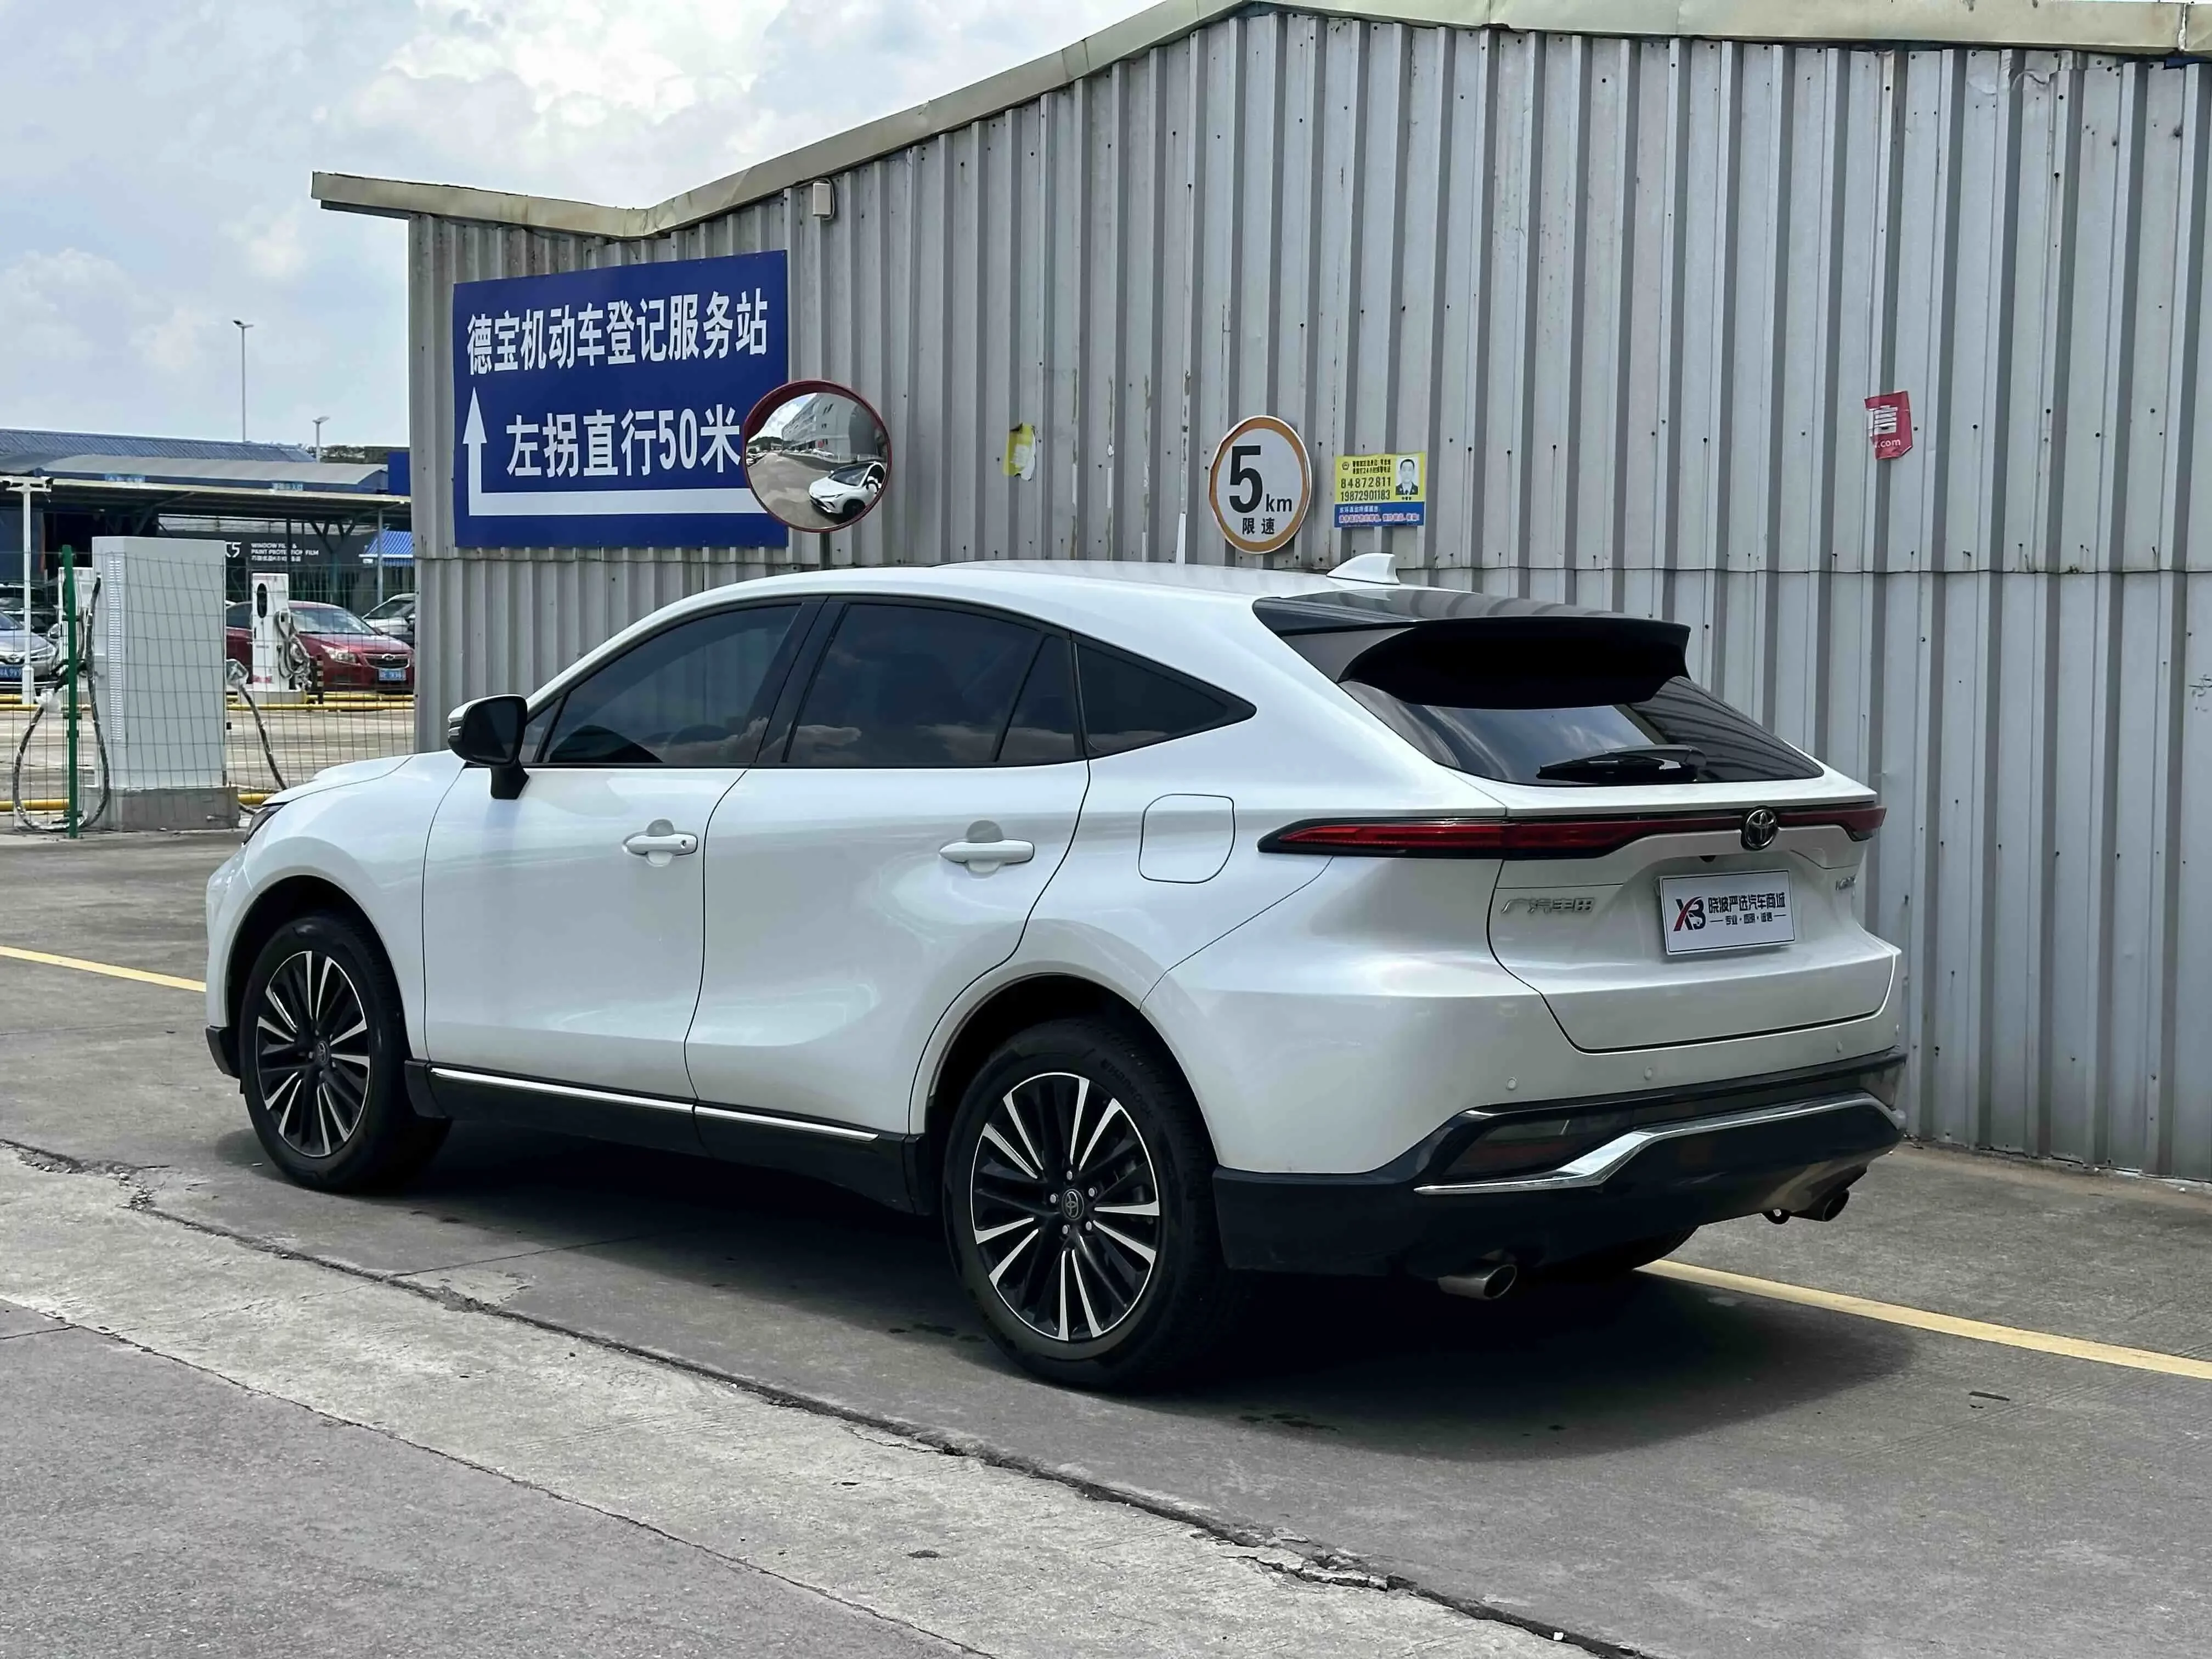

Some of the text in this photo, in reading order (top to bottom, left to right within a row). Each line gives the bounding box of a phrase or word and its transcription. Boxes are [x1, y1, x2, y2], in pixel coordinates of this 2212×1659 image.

[467, 288, 768, 375] 德宝机动车登记服务站
[506, 404, 741, 478] 左拐直行50米
[1341, 476, 1391, 489] 84872811
[1242, 518, 1275, 536] 限速
[1708, 892, 1786, 913] 晓波严选汽车商城
